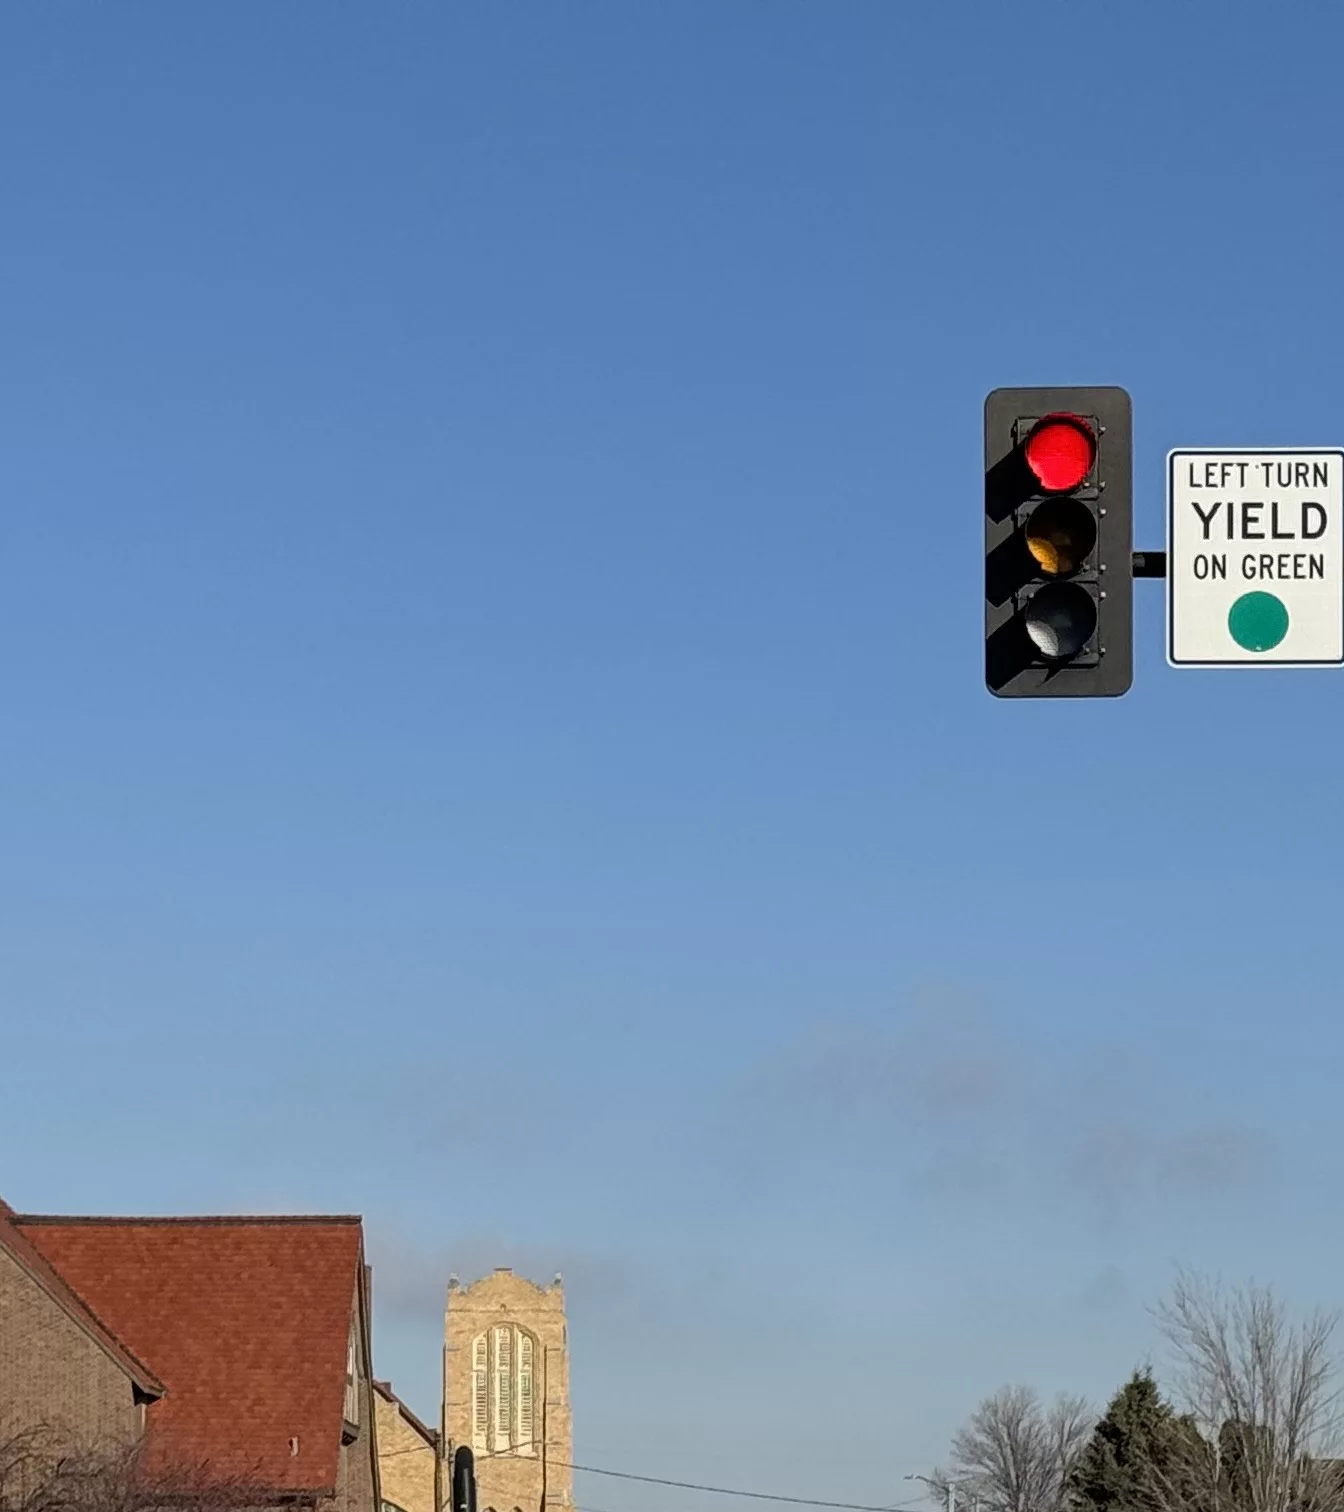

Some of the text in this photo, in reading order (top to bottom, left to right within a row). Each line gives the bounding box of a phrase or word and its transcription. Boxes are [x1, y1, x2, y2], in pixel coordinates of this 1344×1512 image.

[1189, 462, 1328, 488] LEFT TURN
[1191, 502, 1328, 540] YIELD
[1193, 554, 1324, 579] ON GREEN
